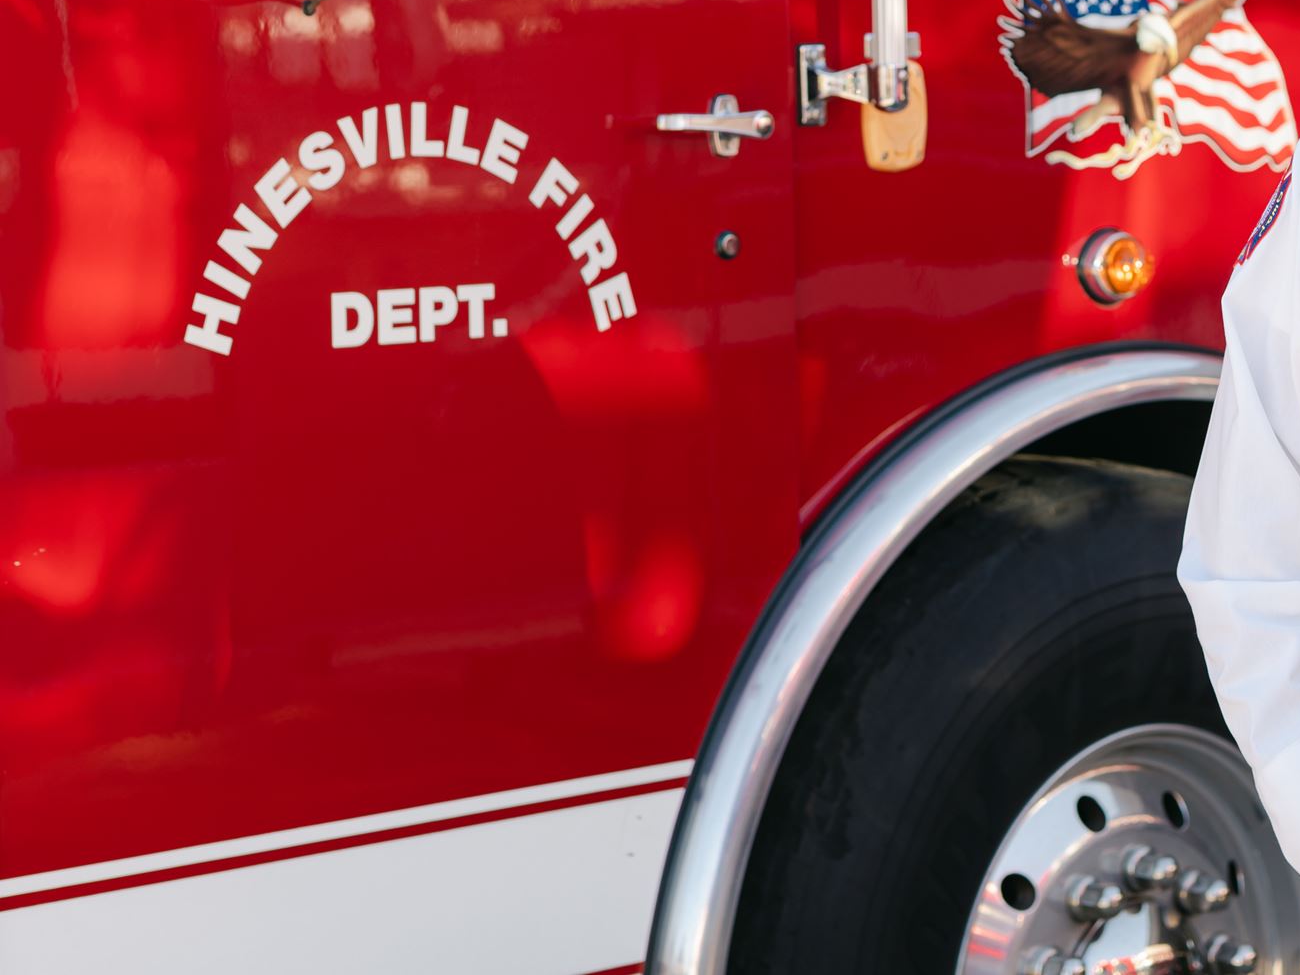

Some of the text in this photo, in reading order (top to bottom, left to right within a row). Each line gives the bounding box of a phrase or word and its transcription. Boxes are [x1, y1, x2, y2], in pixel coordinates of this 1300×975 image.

[184, 102, 637, 356] HINESVILLE FIRE
[331, 283, 508, 349] DEPT.
